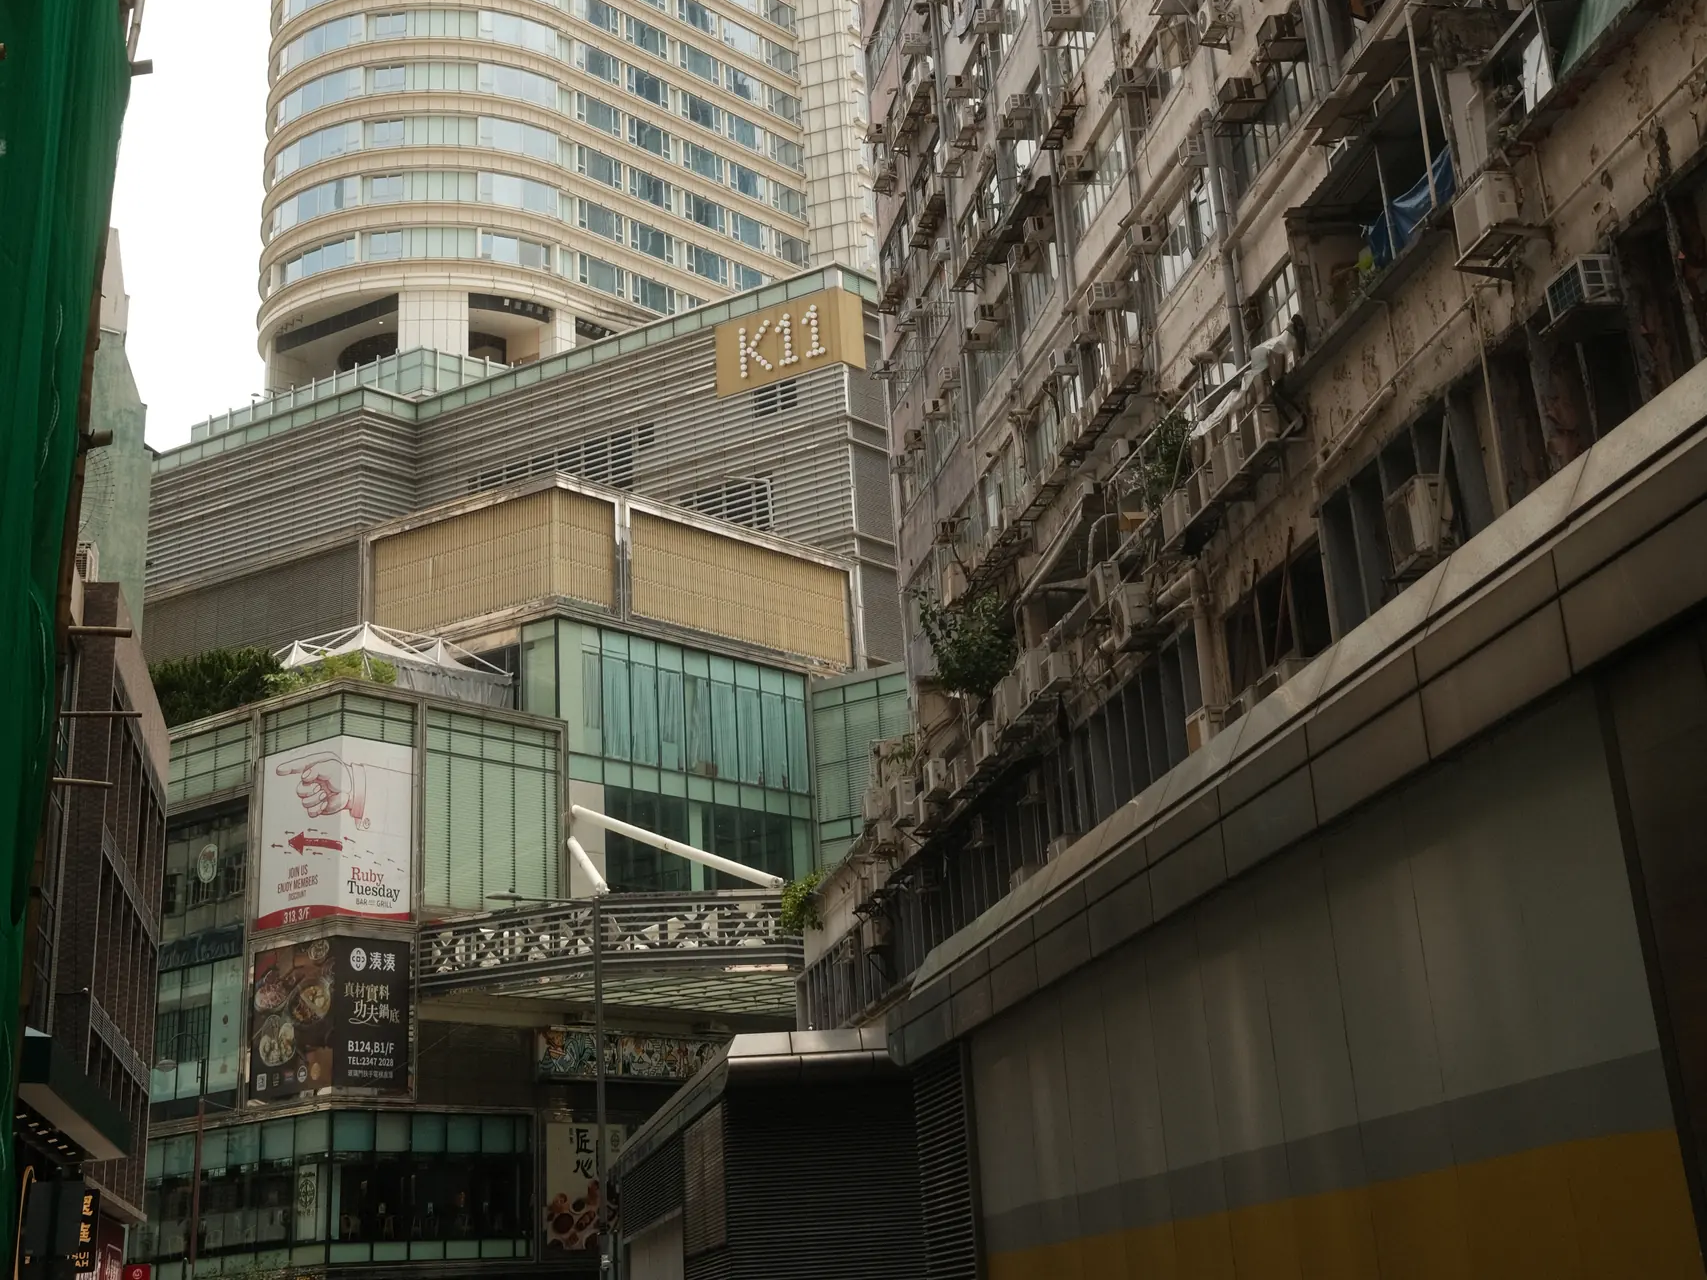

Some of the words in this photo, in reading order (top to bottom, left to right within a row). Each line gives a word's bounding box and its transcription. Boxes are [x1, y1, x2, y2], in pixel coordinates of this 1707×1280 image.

[739, 304, 825, 379] K11
[288, 866, 300, 879] JOIN
[300, 864, 308, 875] US
[351, 867, 384, 886] Ruby
[277, 880, 293, 894] ENJOY
[293, 875, 318, 891] MEMBERS
[347, 880, 401, 902] Tuesday
[356, 898, 367, 906] BAR
[377, 900, 392, 908] GRILL
[298, 907, 310, 920] 3/F
[369, 952, 396, 972] 湊湊
[344, 981, 389, 1003] 真材實料
[352, 999, 400, 1024] 功夫鍋底
[348, 1040, 394, 1055] B124,B1/F
[378, 1057, 394, 1067] 2028
[573, 1128, 594, 1179] 匠心
